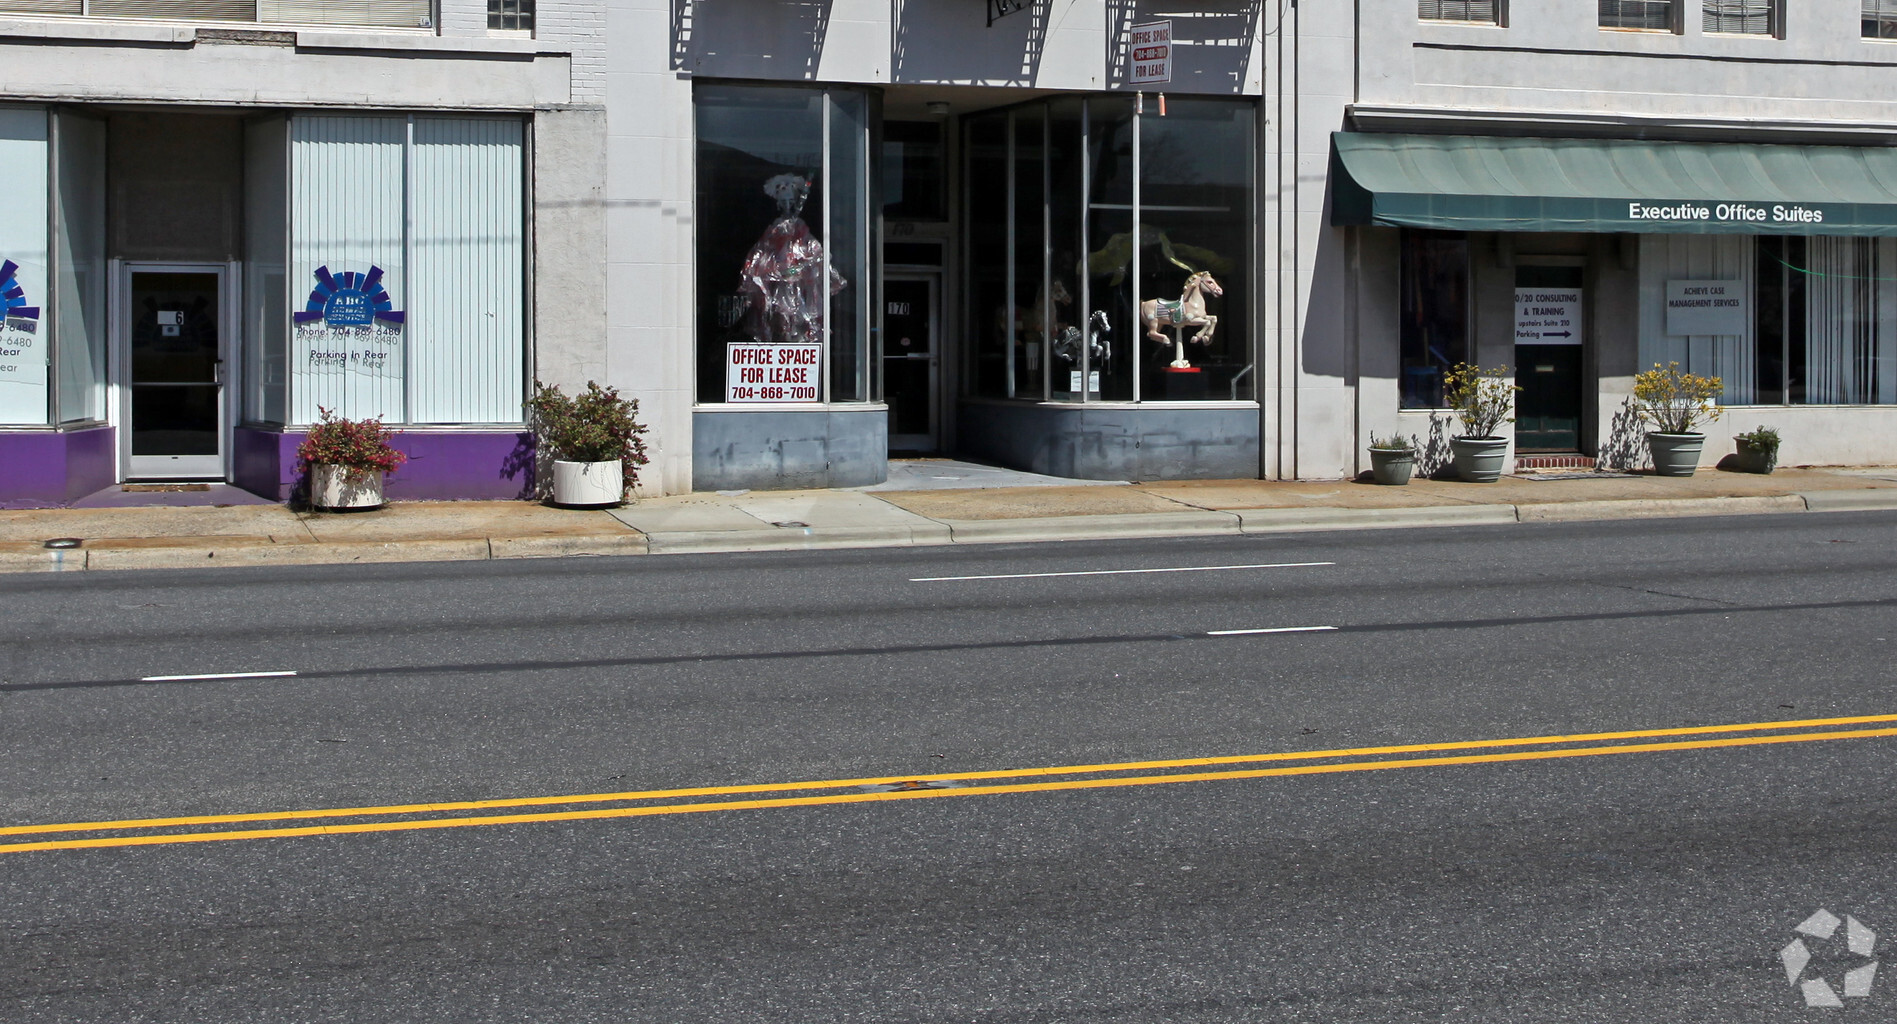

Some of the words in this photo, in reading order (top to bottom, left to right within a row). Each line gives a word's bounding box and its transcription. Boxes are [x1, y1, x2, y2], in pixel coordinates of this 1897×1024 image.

[1132, 31, 1151, 44] OFFICE
[1153, 29, 1169, 42] SPACE
[1136, 65, 1146, 77] FOR
[1148, 63, 1165, 76] LEASE
[1629, 202, 1710, 220] Executive
[1715, 203, 1767, 221] Office
[1772, 205, 1823, 223] Suites
[1684, 287, 1708, 295] ACHIEVE
[1710, 287, 1725, 295] CASE
[1536, 294, 1577, 303] CONSULTING
[1669, 299, 1712, 308] MANAGEMENT
[1714, 299, 1739, 307] SERVICES
[889, 302, 908, 314] 170
[1532, 307, 1565, 316] TRAINING
[175, 311, 183, 325] 6
[1518, 320, 1541, 328] upstairs
[1543, 319, 1558, 327] Suite
[298, 327, 328, 336] Phone:
[332, 327, 401, 336] 704-869-6480
[1516, 330, 1540, 339] Parking
[311, 349, 347, 361] Parking
[351, 350, 360, 359] In
[365, 350, 388, 359] Rear
[732, 348, 773, 365] OFFICE
[778, 349, 817, 365] SPACE
[741, 367, 764, 383] FOR
[769, 367, 807, 383] LEASE
[732, 386, 815, 399] 704-868-7010
